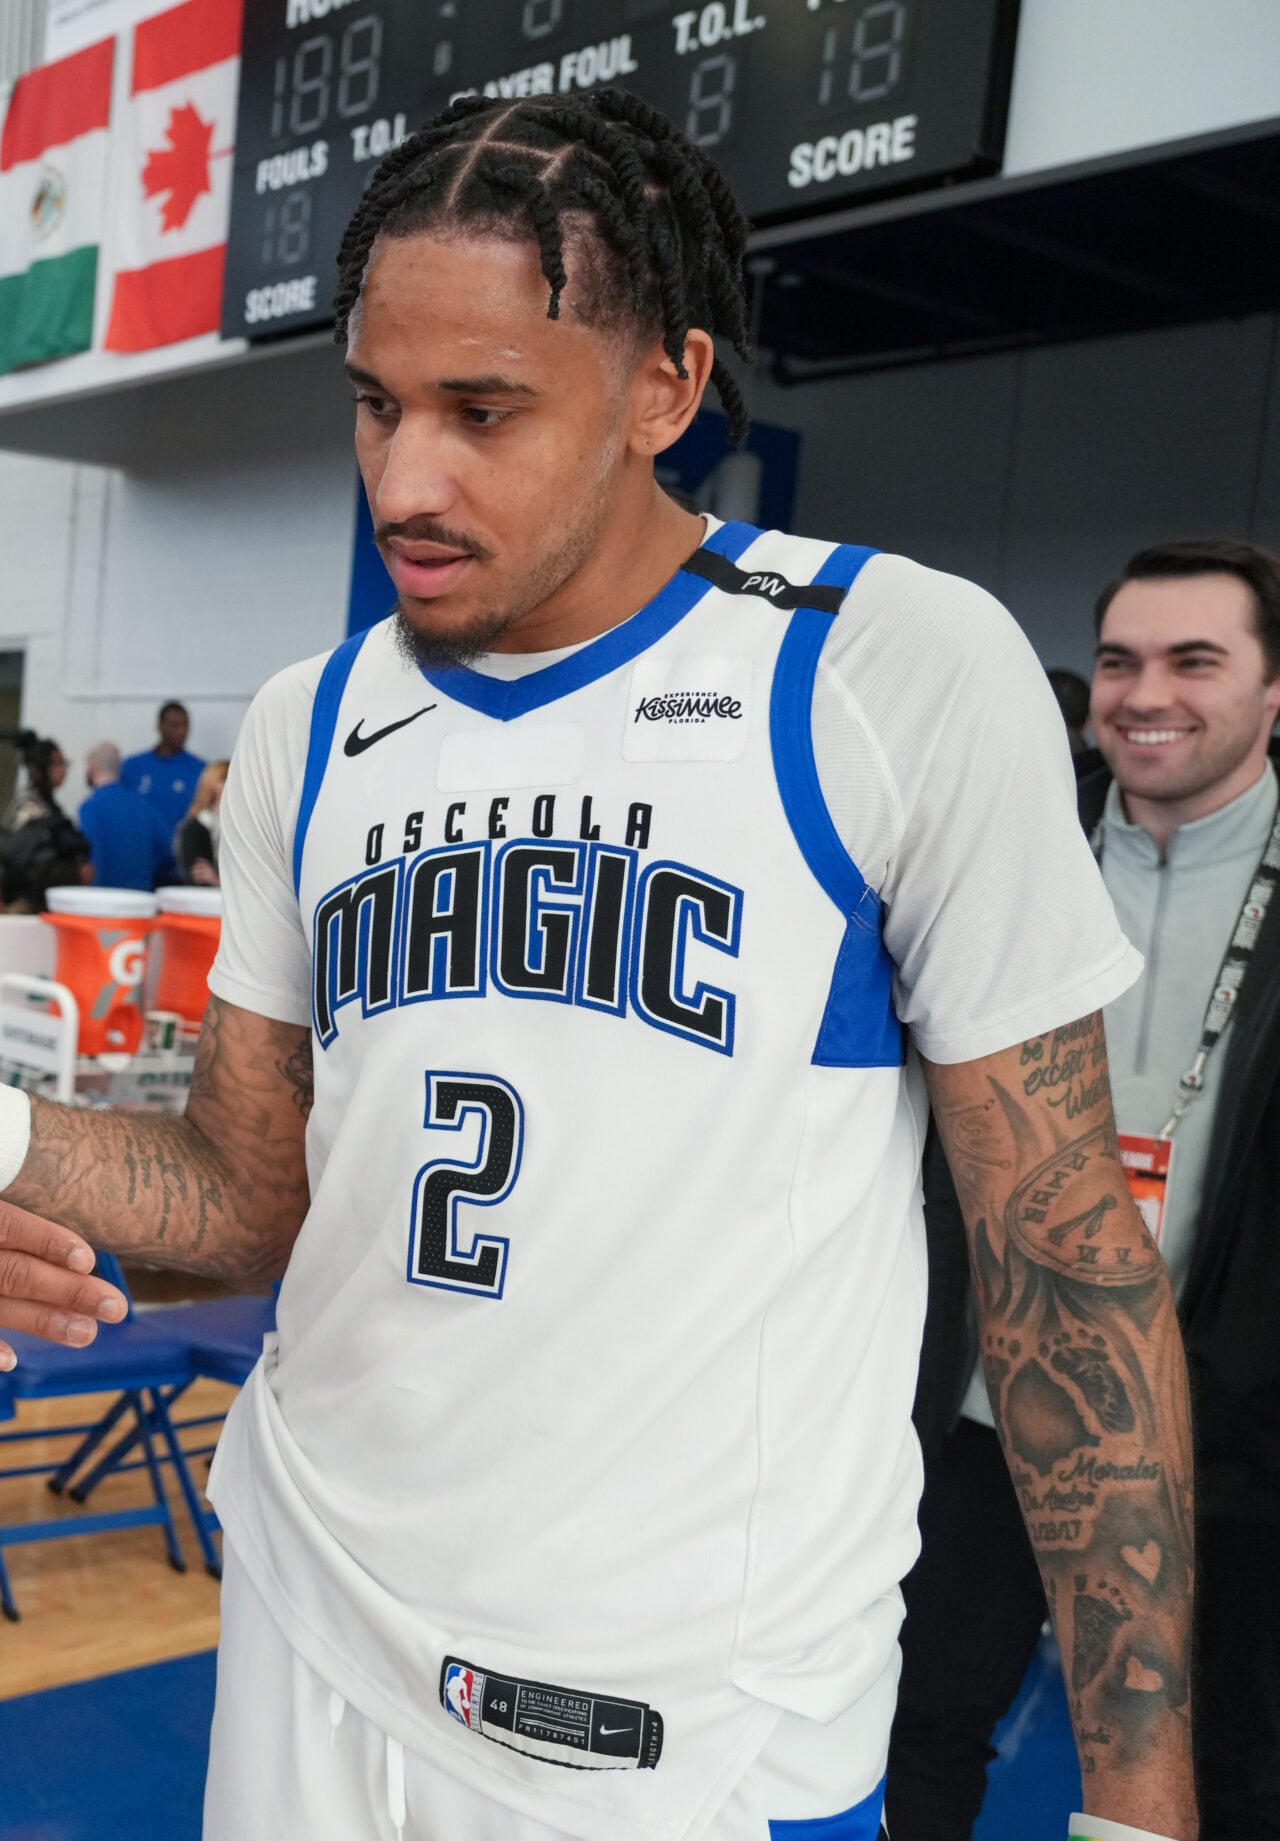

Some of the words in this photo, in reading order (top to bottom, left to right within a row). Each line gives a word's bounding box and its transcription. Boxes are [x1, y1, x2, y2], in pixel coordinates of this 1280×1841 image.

[672, 0, 767, 55] T.O.L.
[558, 33, 639, 94] FOUL
[351, 113, 418, 163] T.O.L
[787, 113, 918, 189] SCORE
[256, 140, 329, 194] FOULS
[244, 274, 317, 325] SCORE
[741, 575, 786, 597] PW
[365, 795, 653, 866] OSCEOLA
[109, 940, 145, 985] G
[312, 838, 744, 1058] MAGIC
[407, 1070, 524, 1300] 2
[490, 1699, 508, 1712] 48
[521, 1690, 589, 1711] ENGINEERED
